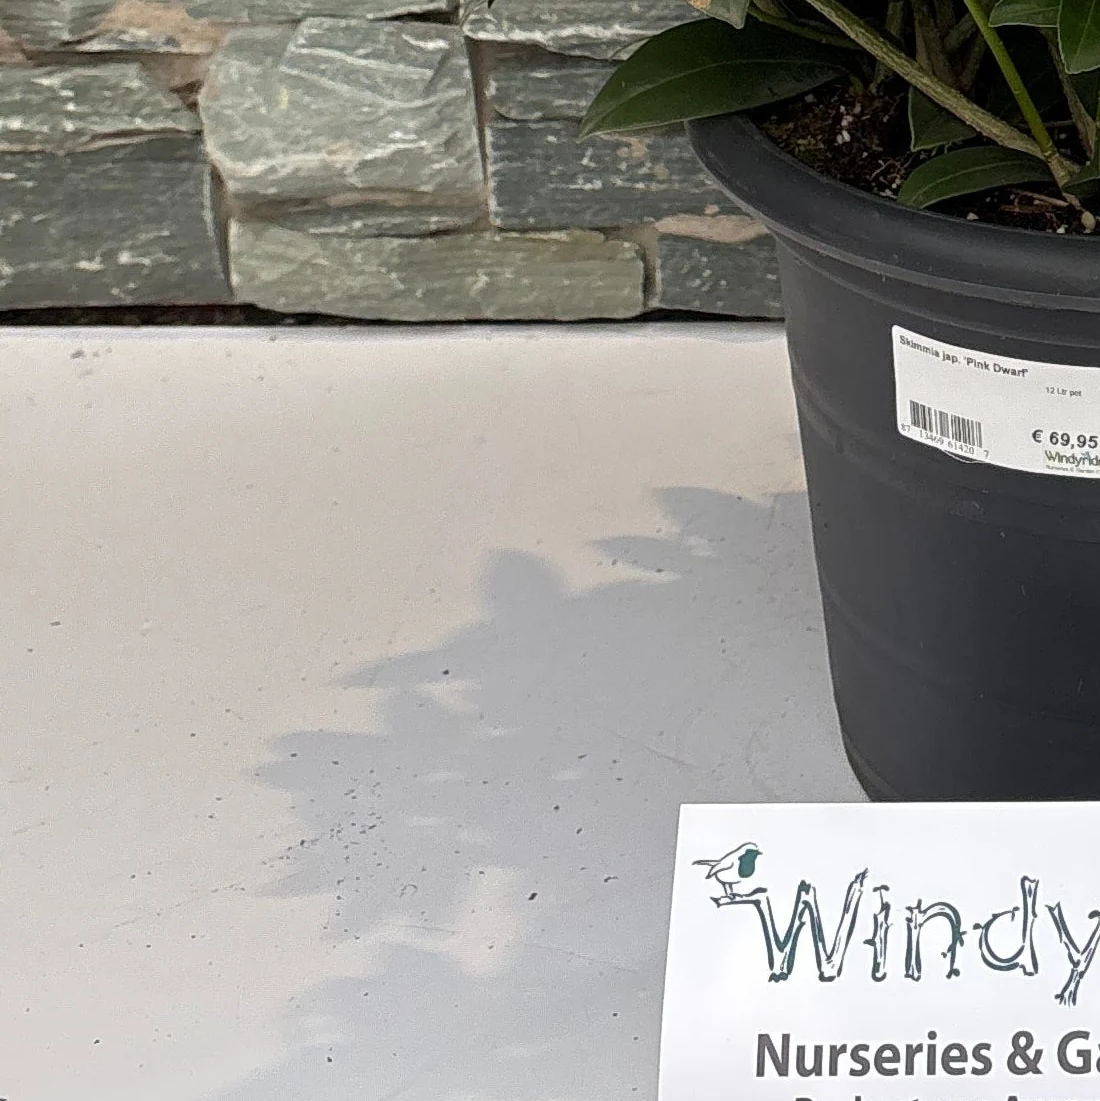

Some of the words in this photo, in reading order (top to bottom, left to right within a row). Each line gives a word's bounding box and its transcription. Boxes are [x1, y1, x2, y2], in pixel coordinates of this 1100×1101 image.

[899, 335, 940, 358] Skimmia
[942, 350, 961, 364] jap.
[1046, 387, 1055, 395] 12
[947, 440, 975, 455] 61420
[983, 449, 990, 459] 7
[1032, 429, 1044, 443] €
[1049, 431, 1099, 450] 69,95
[756, 1030, 993, 1077] Nurseries
[1006, 1030, 1044, 1076] &
